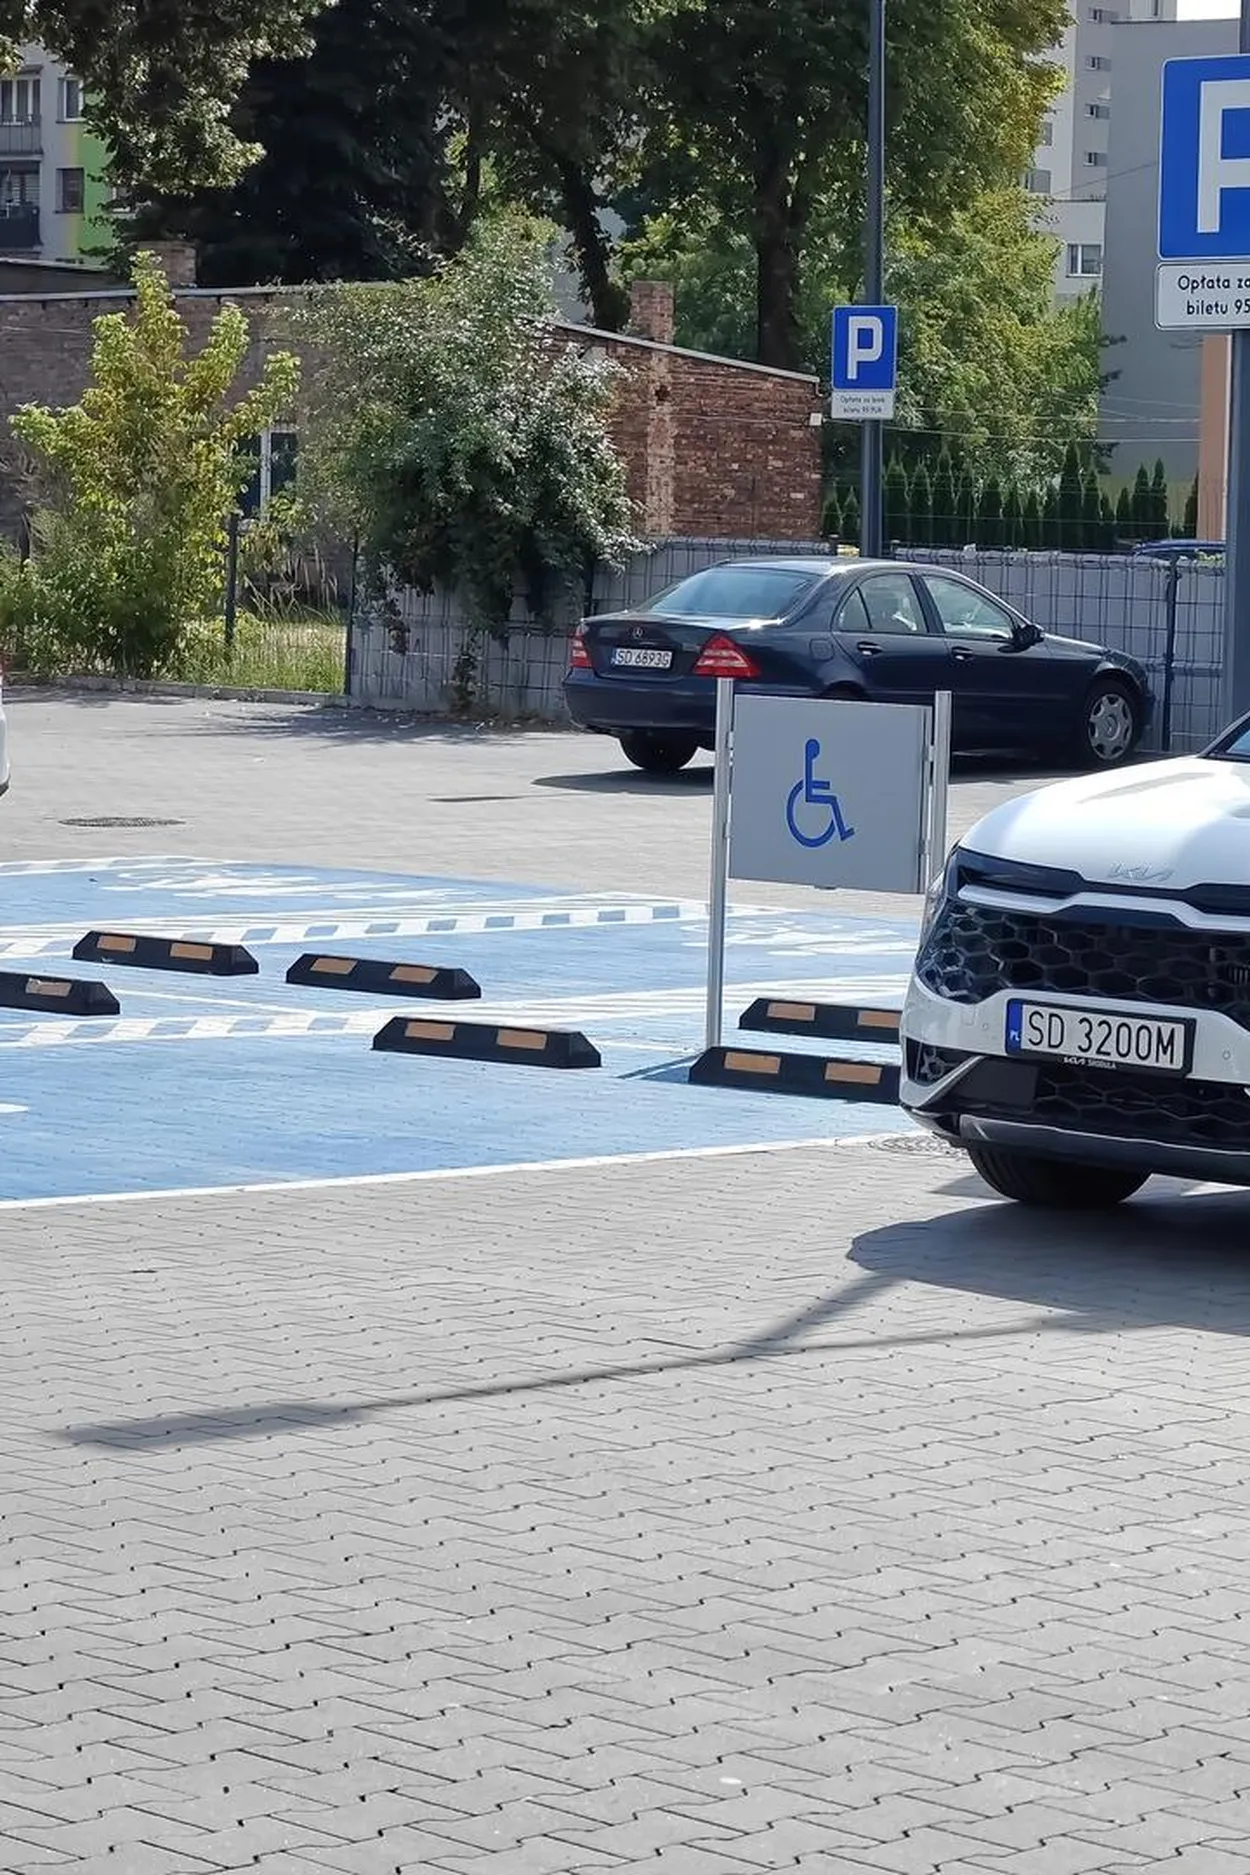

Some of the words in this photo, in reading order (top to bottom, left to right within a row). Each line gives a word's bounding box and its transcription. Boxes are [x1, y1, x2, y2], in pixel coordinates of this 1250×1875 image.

[1177, 274, 1231, 293] Opłata
[1186, 300, 1229, 315] biletu
[1234, 299, 1250, 314] 95
[847, 315, 883, 380] P
[618, 650, 632, 664] SD
[1028, 1010, 1064, 1048] SD
[1078, 1017, 1175, 1064] 3200M
